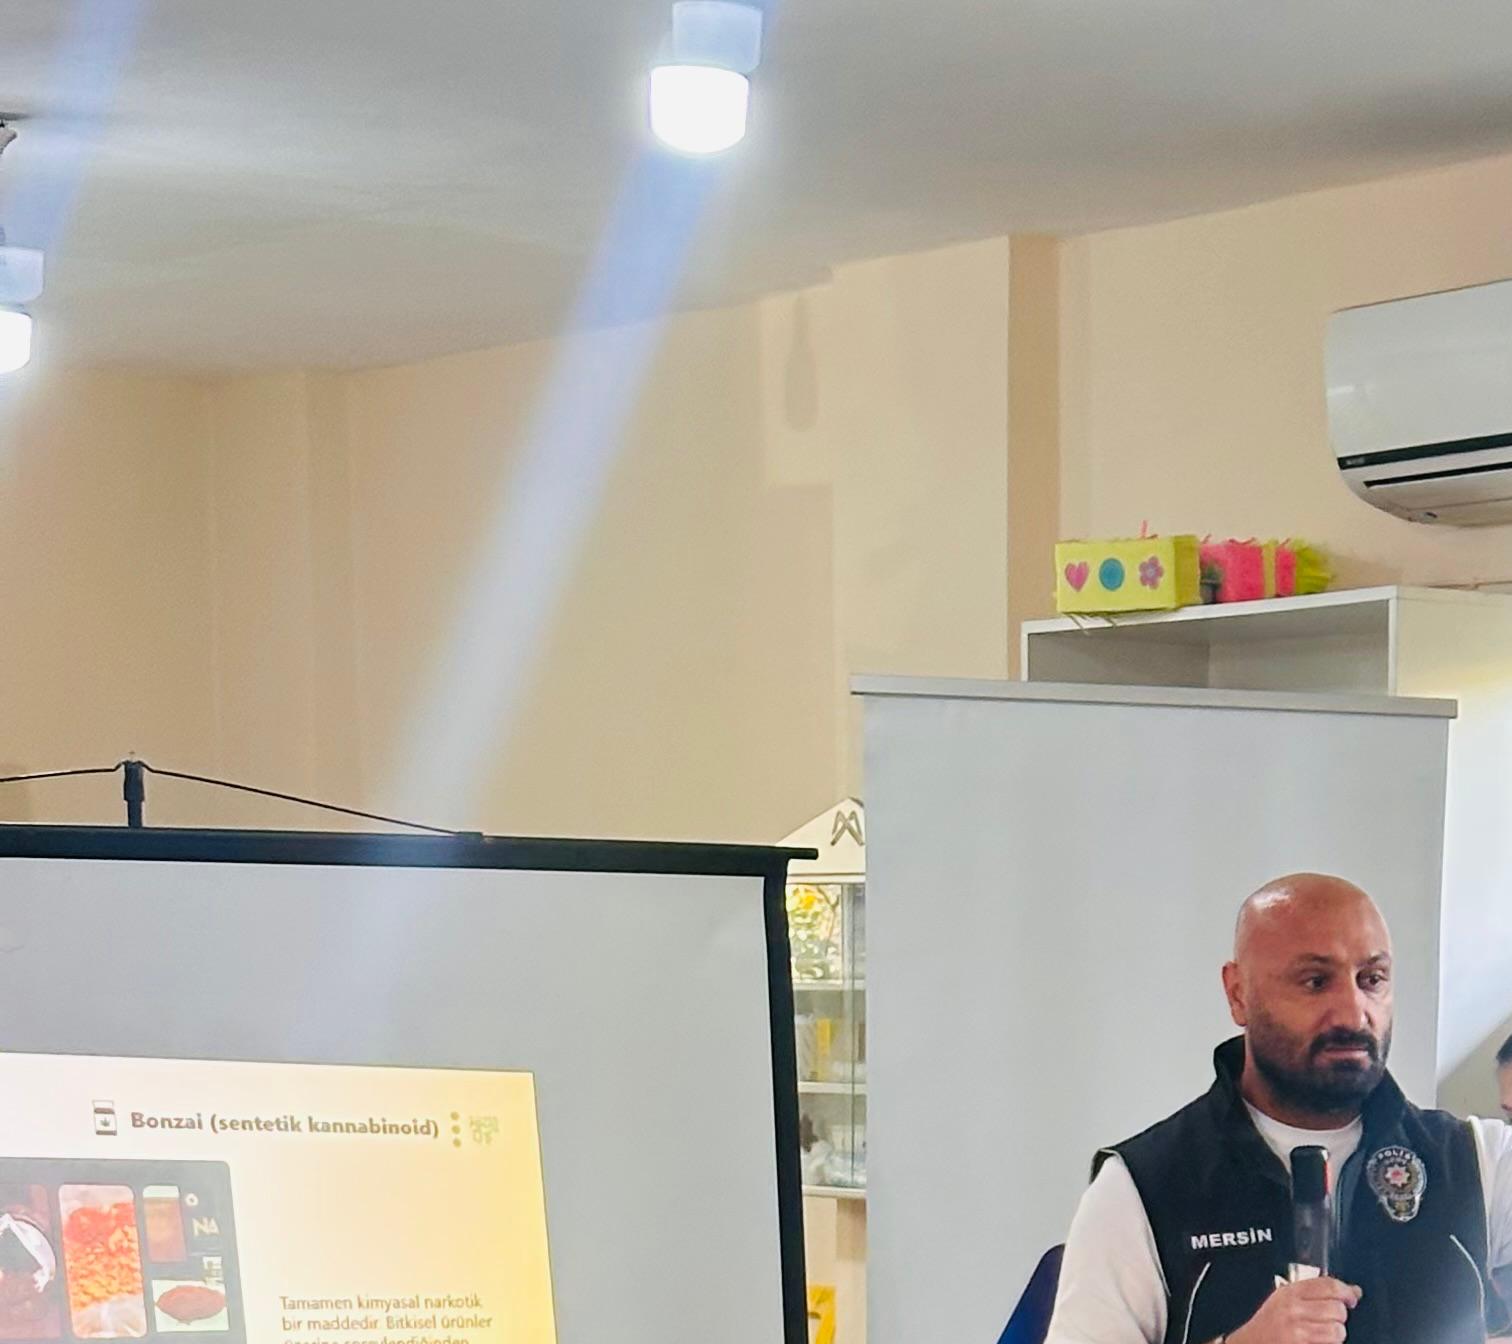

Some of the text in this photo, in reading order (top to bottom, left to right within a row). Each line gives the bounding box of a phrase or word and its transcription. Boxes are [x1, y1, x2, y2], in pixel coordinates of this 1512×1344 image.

[130, 1111, 440, 1139] Bonzai (sentetik kannabinoid)
[1190, 1226, 1273, 1250] MERSİN
[279, 1292, 483, 1313] Tamamen kimyasal narkotik
[282, 1316, 303, 1331] bir
[386, 1314, 437, 1329] Bitkisel
[441, 1313, 493, 1329] ürünler
